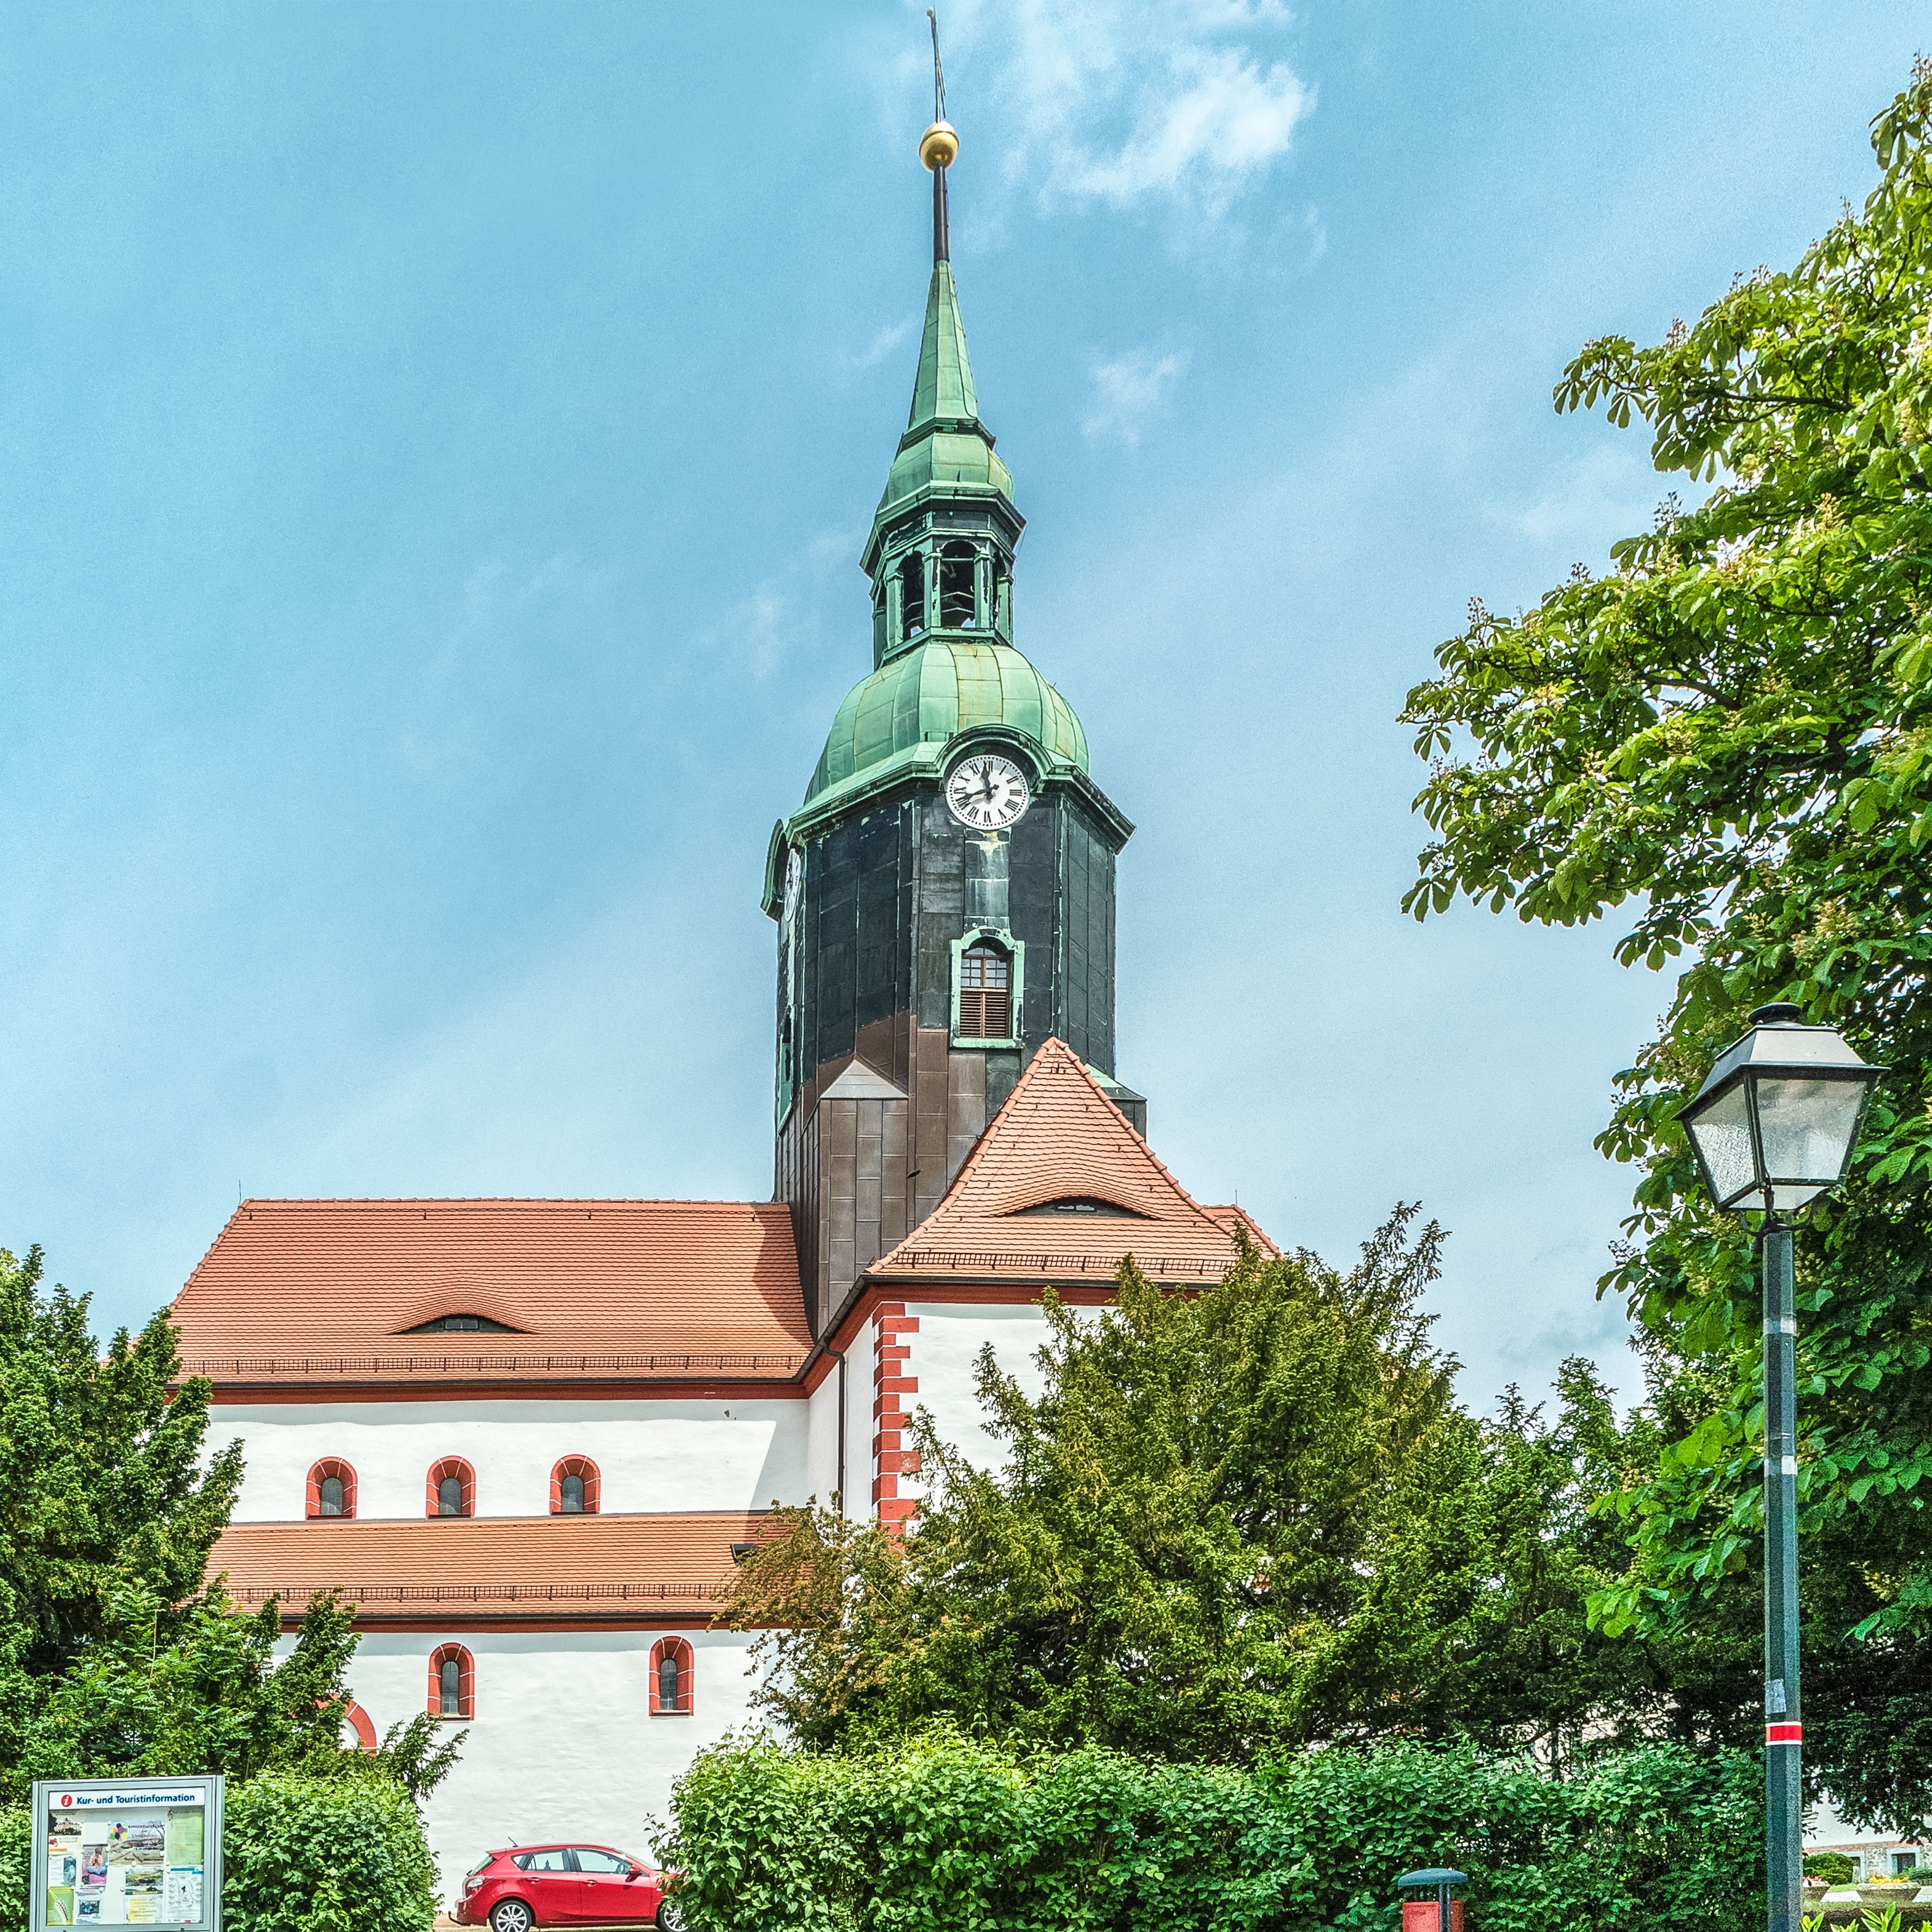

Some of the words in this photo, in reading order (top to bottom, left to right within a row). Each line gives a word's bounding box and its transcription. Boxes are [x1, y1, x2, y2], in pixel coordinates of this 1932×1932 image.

[968, 763, 980, 776] XI
[999, 765, 1007, 775] I
[957, 773, 970, 783] X
[1006, 775, 1019, 784] II
[984, 810, 991, 823] VI
[998, 808, 1007, 820] V
[97, 1795, 113, 1804] und
[115, 1794, 195, 1803] Touristinformation
